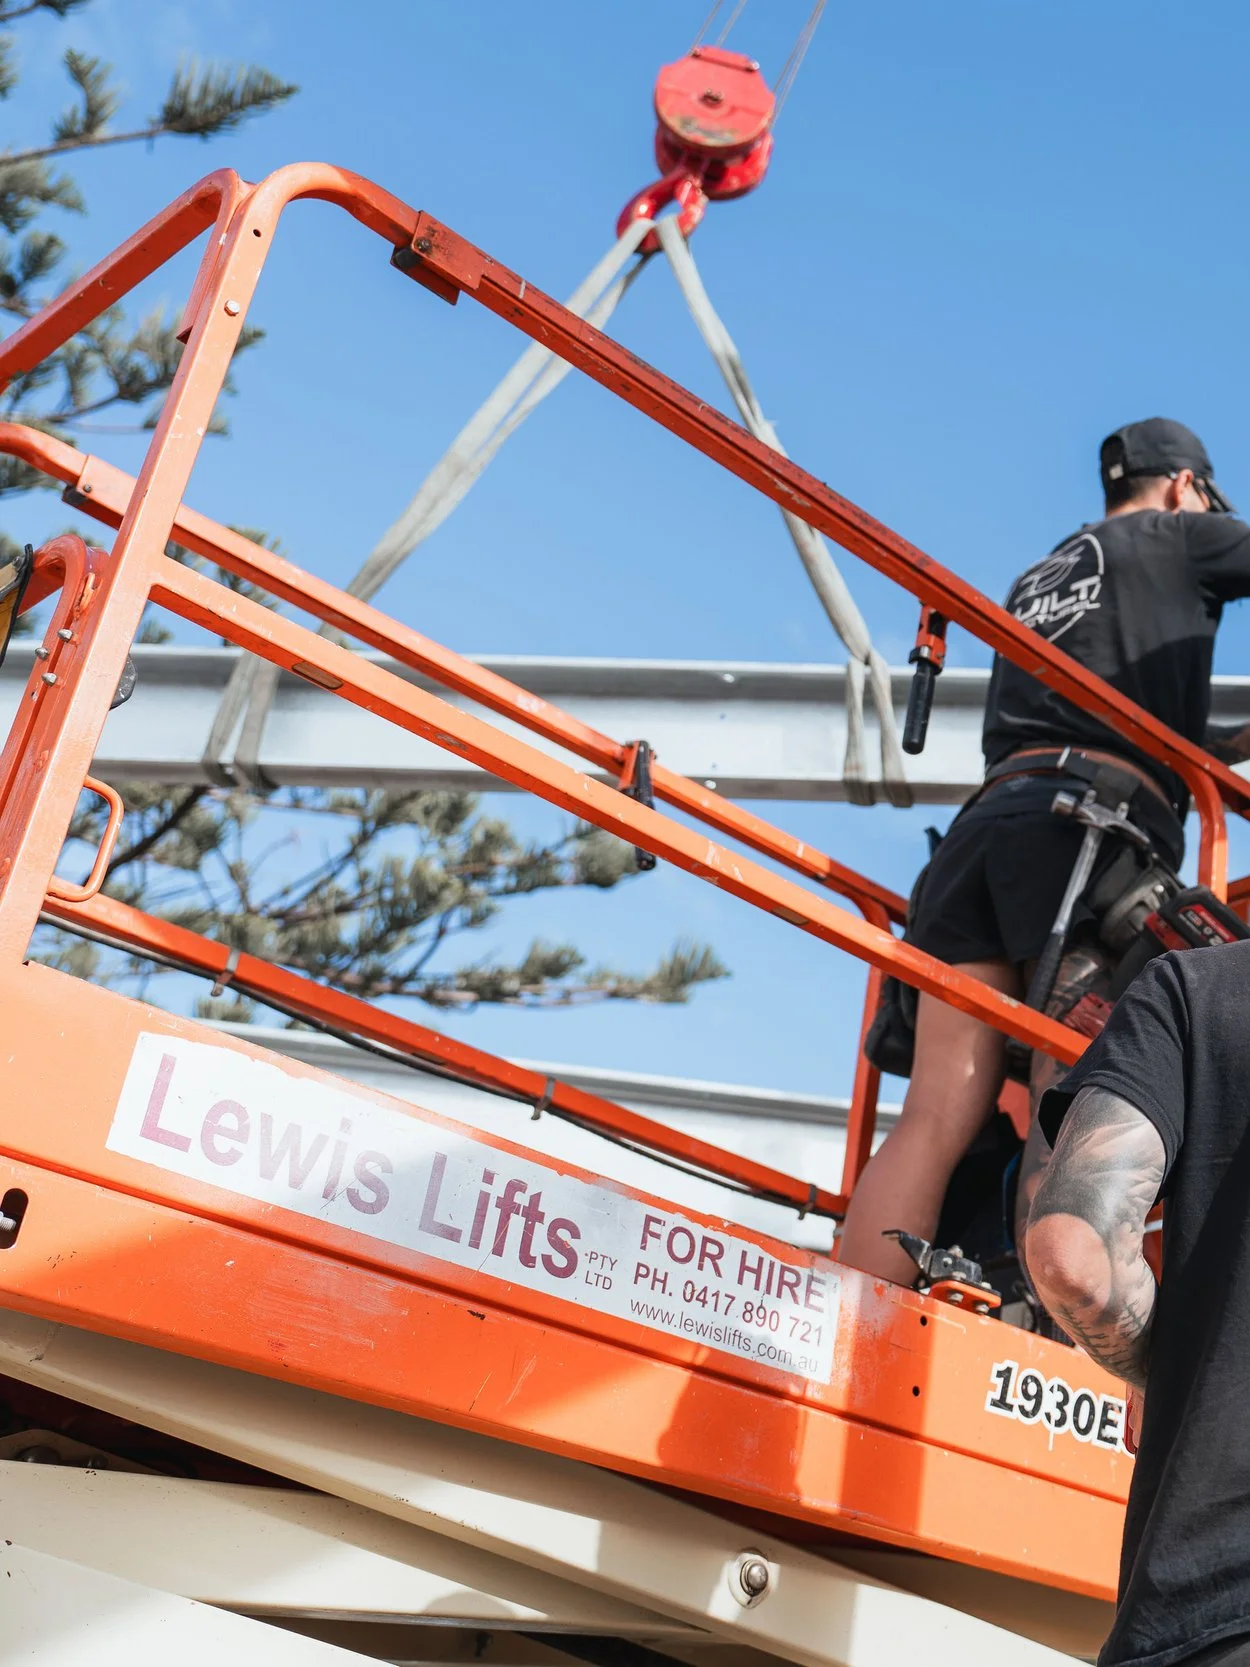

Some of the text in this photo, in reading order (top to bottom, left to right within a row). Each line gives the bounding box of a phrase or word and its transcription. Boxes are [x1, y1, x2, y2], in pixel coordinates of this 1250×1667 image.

[1015, 575, 1101, 622] UILT
[139, 1053, 581, 1279] Lewis Lifts
[585, 1270, 613, 1290] LTD
[640, 1214, 827, 1314] FOR HIRE
[630, 1299, 819, 1373] www.lewislifts.com.au
[633, 1262, 822, 1347] PH. 0417 890 721
[990, 1366, 1128, 1446] 1930E
